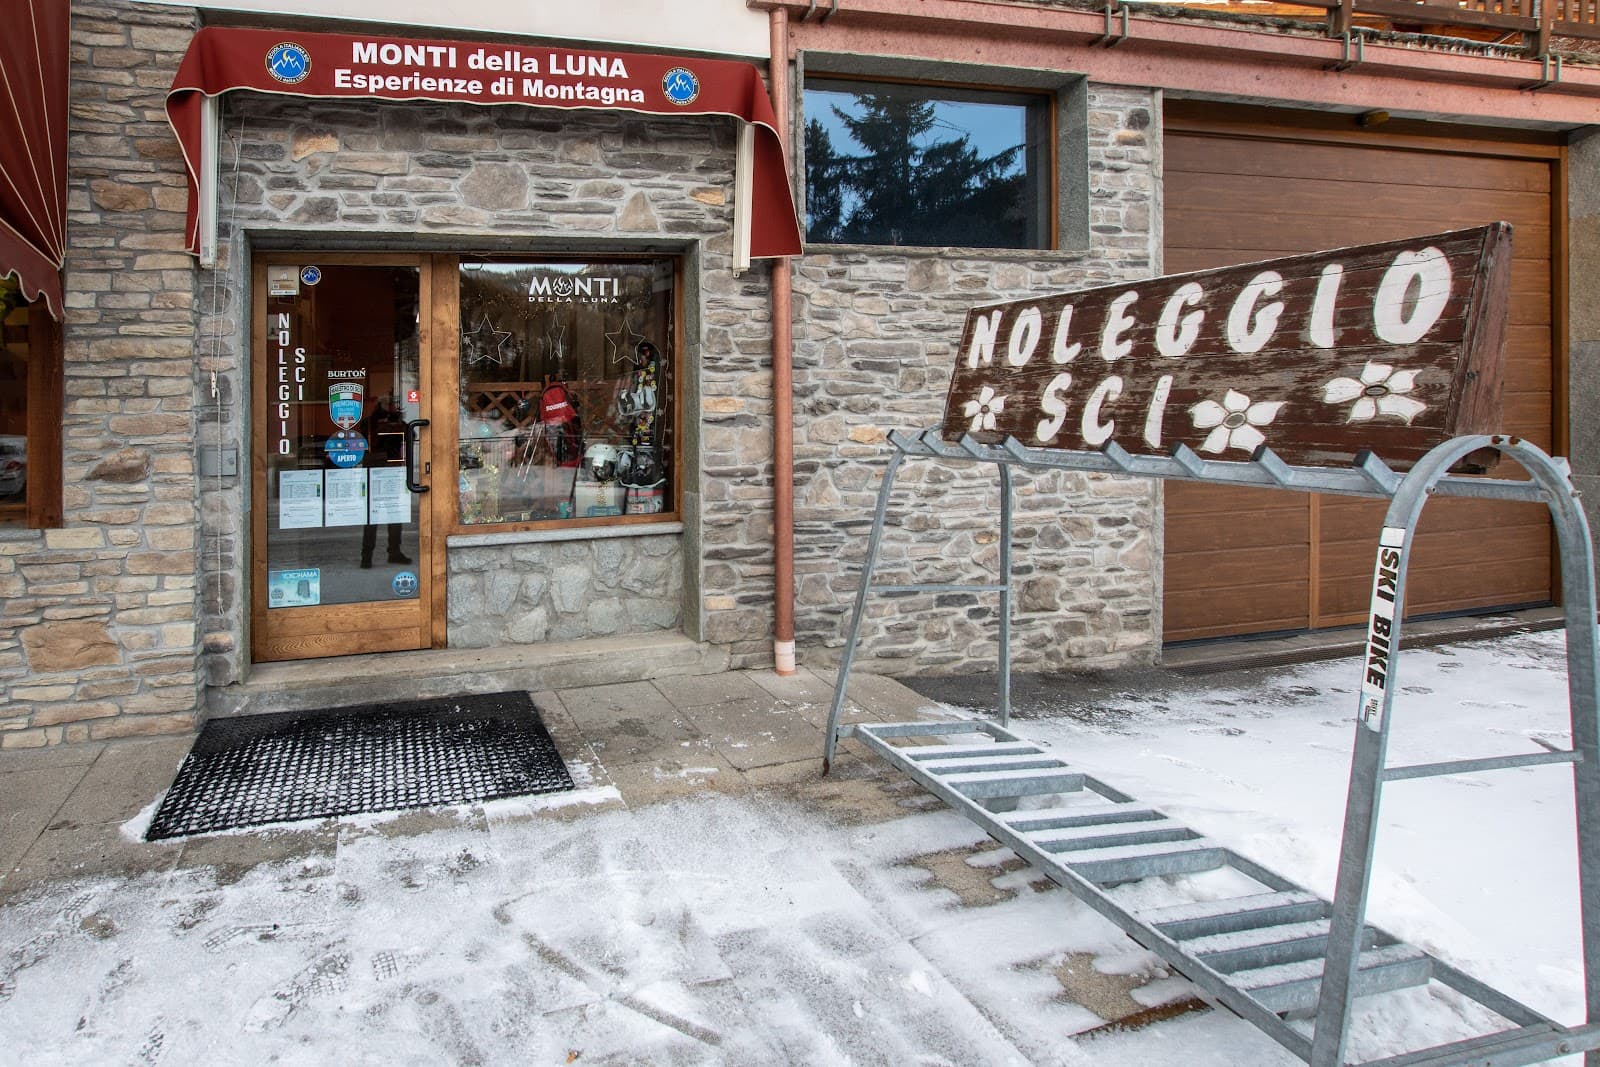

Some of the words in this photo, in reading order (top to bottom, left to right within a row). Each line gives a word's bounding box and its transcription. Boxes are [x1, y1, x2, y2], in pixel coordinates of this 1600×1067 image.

[334, 68, 483, 95] Esperienze
[490, 76, 514, 96] di
[522, 78, 645, 105] Montagna
[352, 41, 457, 68] MONTI
[467, 48, 539, 74] della
[549, 53, 629, 79] LUNA
[528, 276, 619, 297] MONTI
[967, 245, 1452, 369] NOLEGGIO
[278, 312, 290, 455] NOLEGGIO
[294, 347, 306, 401] SCI
[327, 369, 366, 377] BURTON
[1036, 372, 1174, 450] SCI
[1376, 548, 1400, 603] SKI
[1366, 613, 1393, 690] BIKE
